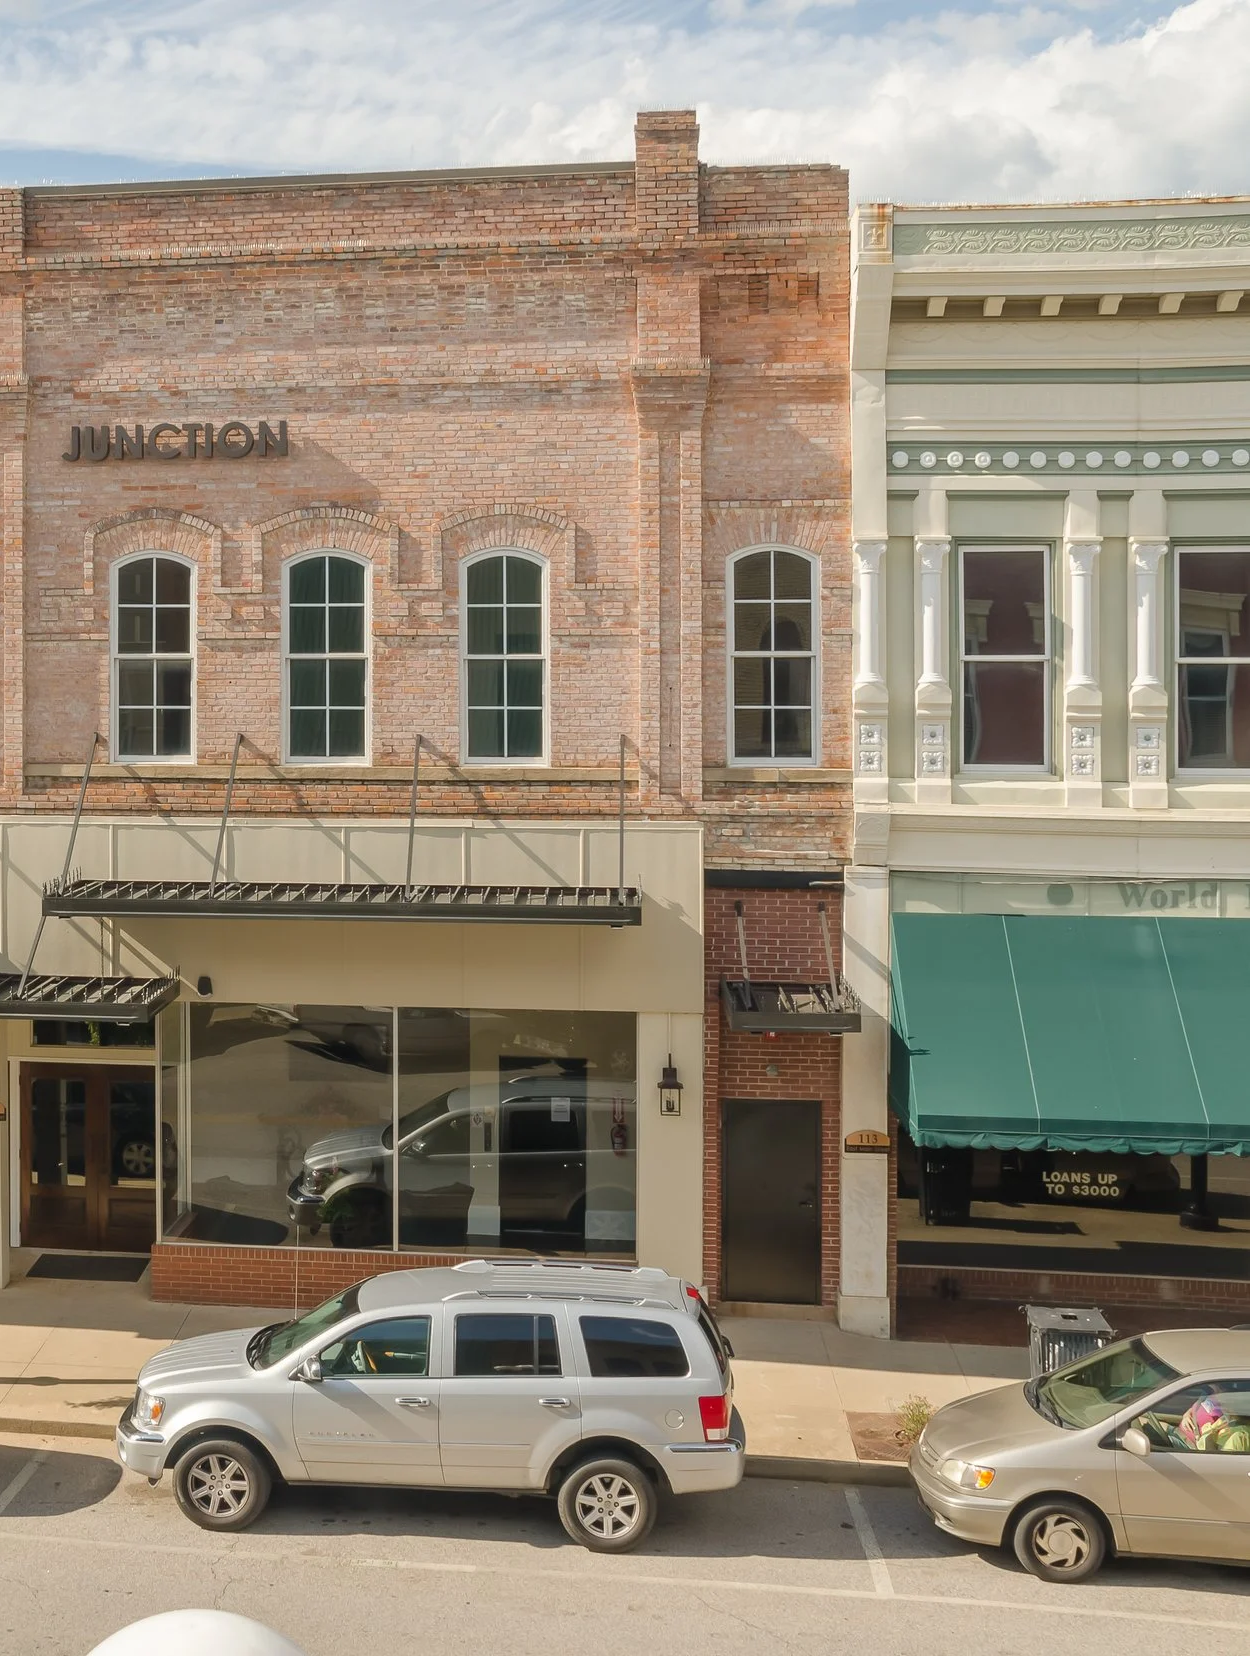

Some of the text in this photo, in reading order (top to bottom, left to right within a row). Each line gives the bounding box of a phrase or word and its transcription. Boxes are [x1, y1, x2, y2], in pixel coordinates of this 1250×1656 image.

[61, 420, 288, 462] JUNCTION
[1118, 883, 1217, 909] World
[859, 1134, 878, 1144] 113
[1042, 1171, 1118, 1184] LOANS UP
[1046, 1184, 1119, 1197] TO $3000
